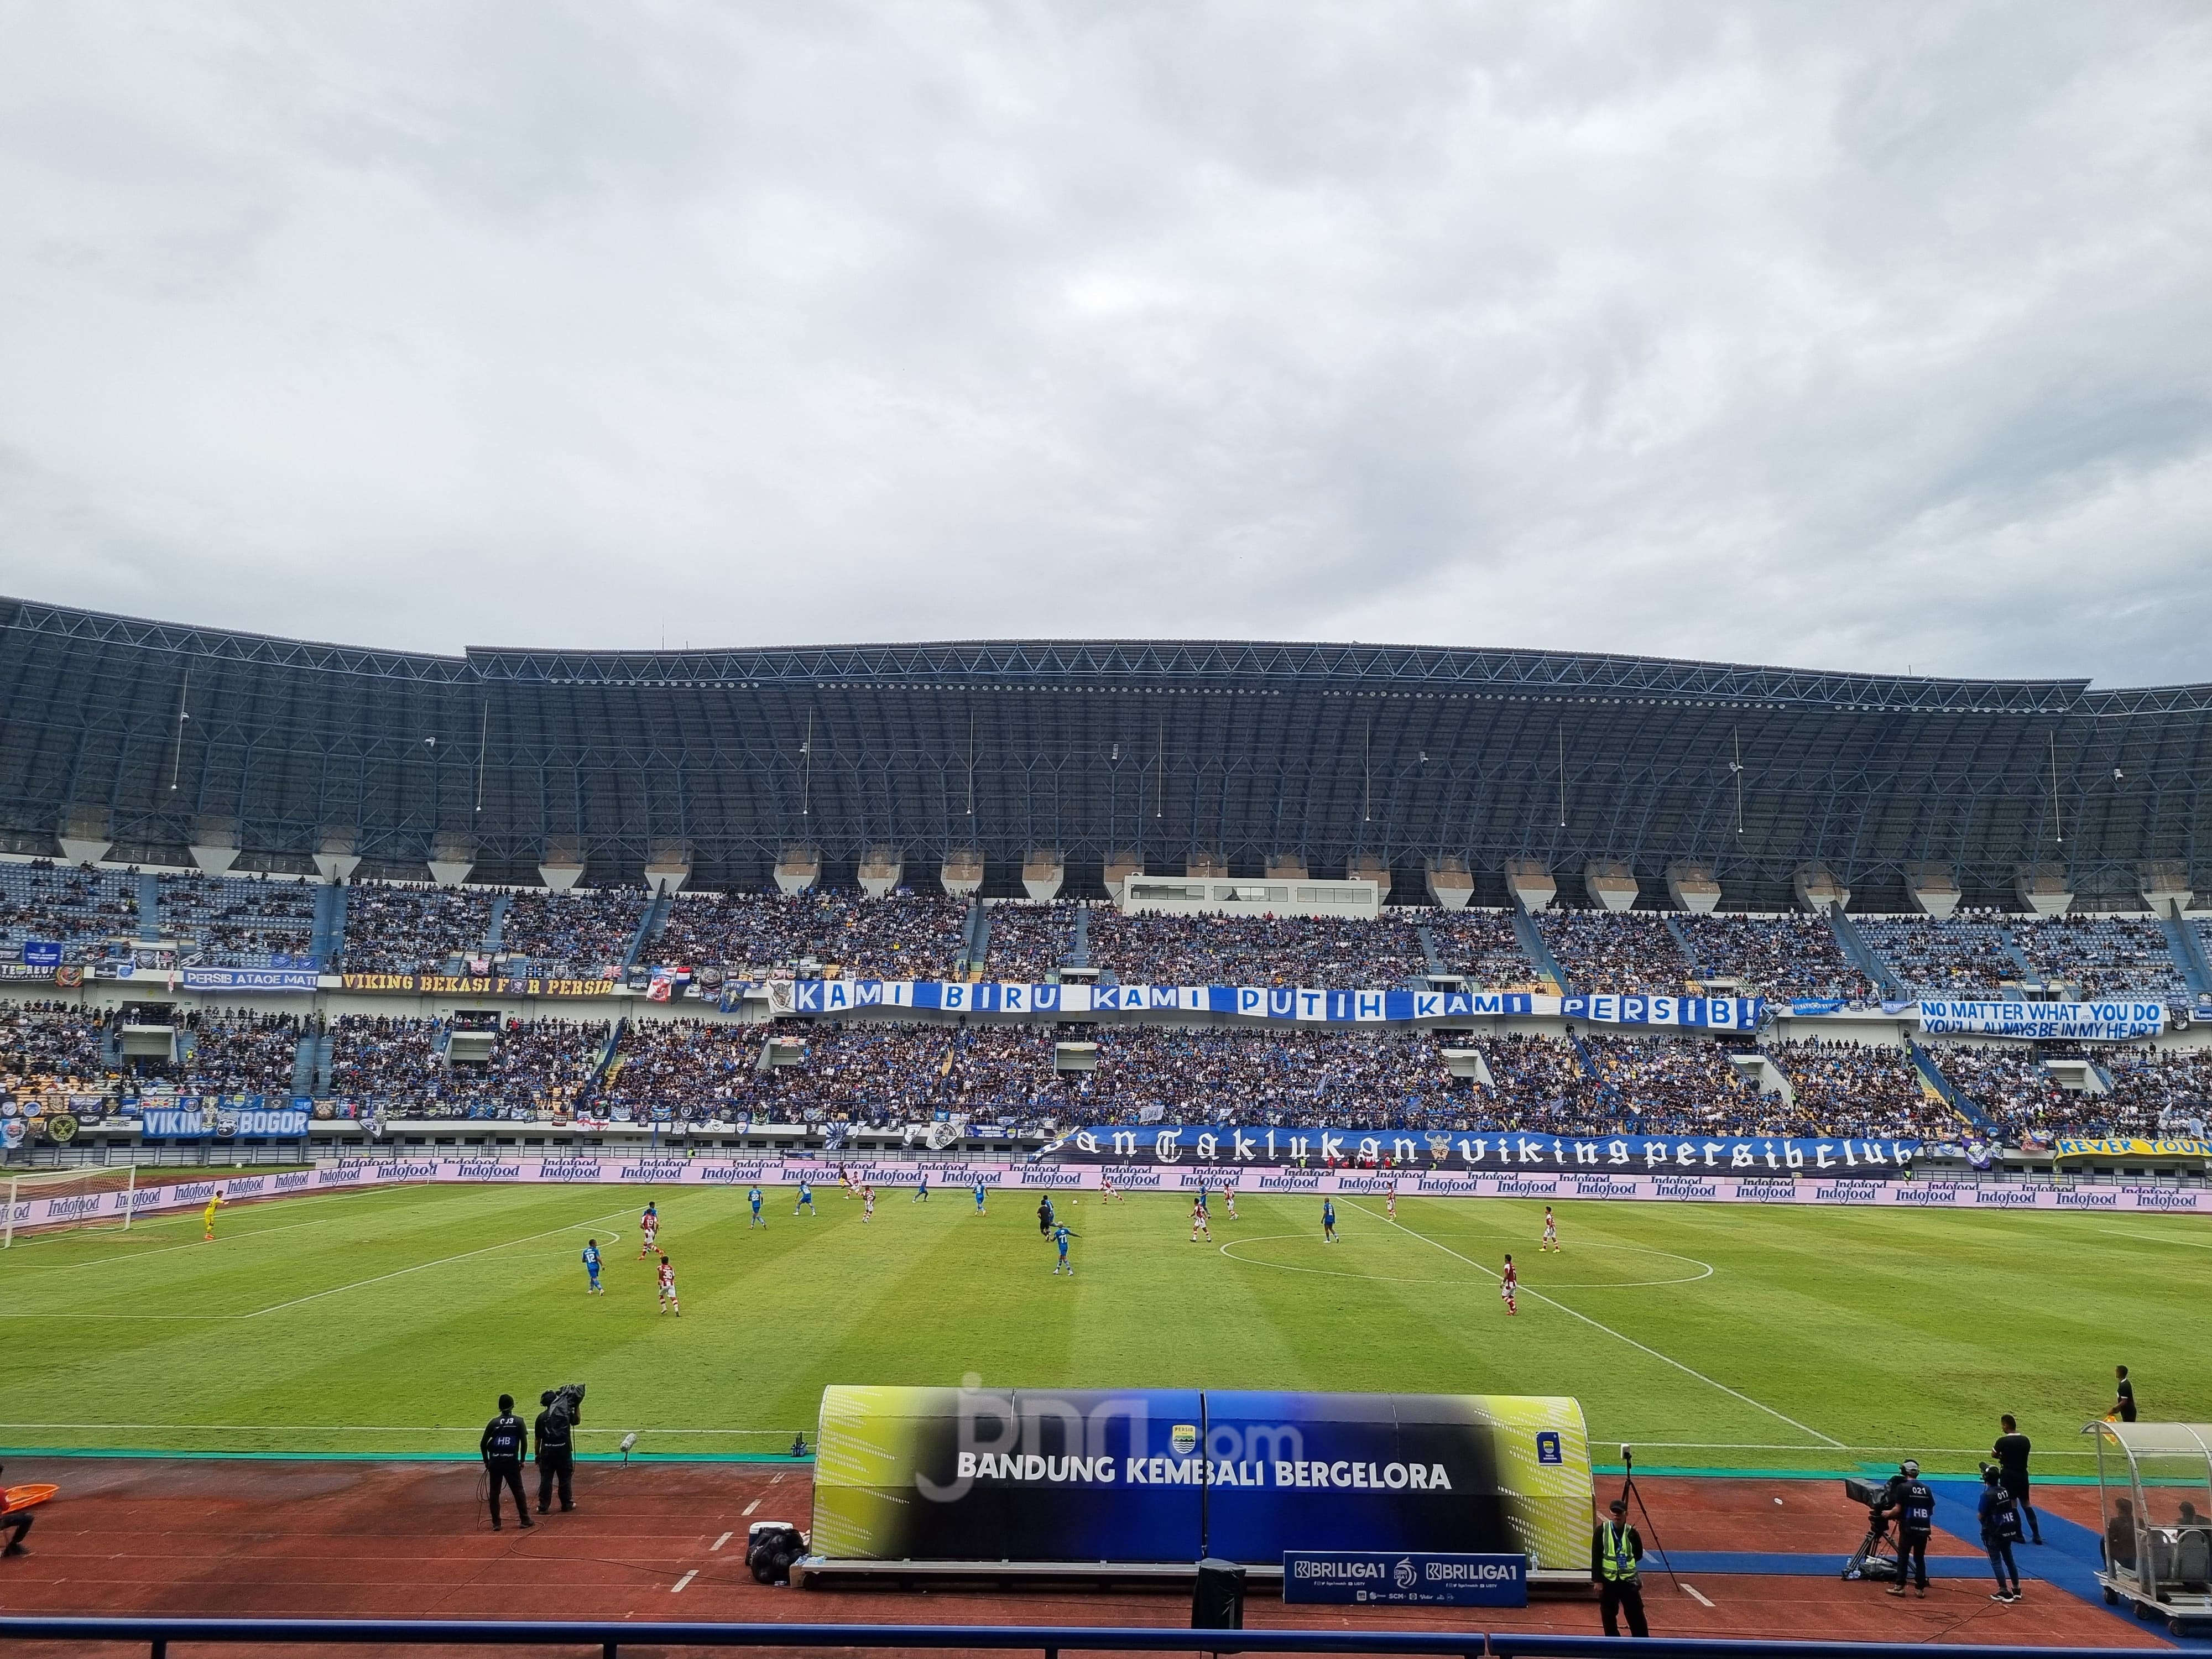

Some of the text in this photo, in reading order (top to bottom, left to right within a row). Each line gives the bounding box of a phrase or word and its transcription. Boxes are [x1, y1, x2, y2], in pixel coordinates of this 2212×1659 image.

[187, 973, 316, 985] PERSIB ATAOE MATI
[342, 974, 414, 989] VIKING
[420, 976, 491, 992] BEKASI
[546, 979, 614, 995] PERSIB
[798, 983, 1755, 1027] KAMI BIRU KAMI PUTIH KAMI PERSIB!
[1921, 1001, 2160, 1021] NO MATTER WHAT YOU DO
[1983, 1022, 2037, 1036] ALWAYS
[2038, 1022, 2059, 1037] BE
[2060, 1022, 2077, 1037] IN
[2078, 1022, 2105, 1039] MY
[2106, 1022, 2161, 1039] HEART
[145, 1111, 309, 1133] VIKIN BOGOR
[319, 1167, 361, 1186] Indofood
[375, 1164, 437, 1181] Indofood
[457, 1164, 519, 1181] Indofood
[539, 1165, 601, 1182] Indofood
[620, 1166, 682, 1183] Indofood
[701, 1167, 762, 1183] Indofood
[860, 1169, 923, 1186] Indofood
[941, 1170, 1001, 1187] Indofood
[1020, 1171, 1081, 1188] Indofood
[226, 1177, 265, 1197] Indofood
[274, 1171, 309, 1192] Indofood
[1180, 1173, 1239, 1191] Indofood
[1259, 1175, 1319, 1192] Indofood
[1338, 1177, 1398, 1193] Indofood
[1417, 1178, 1477, 1195] Indofood
[1496, 1180, 1557, 1197] Indofood
[173, 1182, 216, 1204] Indofood
[1576, 1182, 1636, 1199] Indofood
[1656, 1183, 1716, 1201] Indofood
[1735, 1185, 1796, 1203] Indofood
[1815, 1187, 1875, 1204] Indofood
[1895, 1188, 1955, 1206] Indofood
[1975, 1190, 2036, 1208] Indofood
[48, 1195, 100, 1219] Indofood
[114, 1188, 161, 1211] Inofood
[2056, 1192, 2116, 1209] Indofood
[2136, 1193, 2197, 1211] Indofood
[646, 1219, 654, 1227] 19
[586, 1254, 596, 1263] 12
[663, 1269, 672, 1279] 36
[498, 1437, 511, 1446] HB
[957, 1451, 1453, 1490] BANDUNG KEMBALI BERGELORA
[1997, 1490, 2008, 1500] 017
[1913, 1508, 1928, 1518] HB
